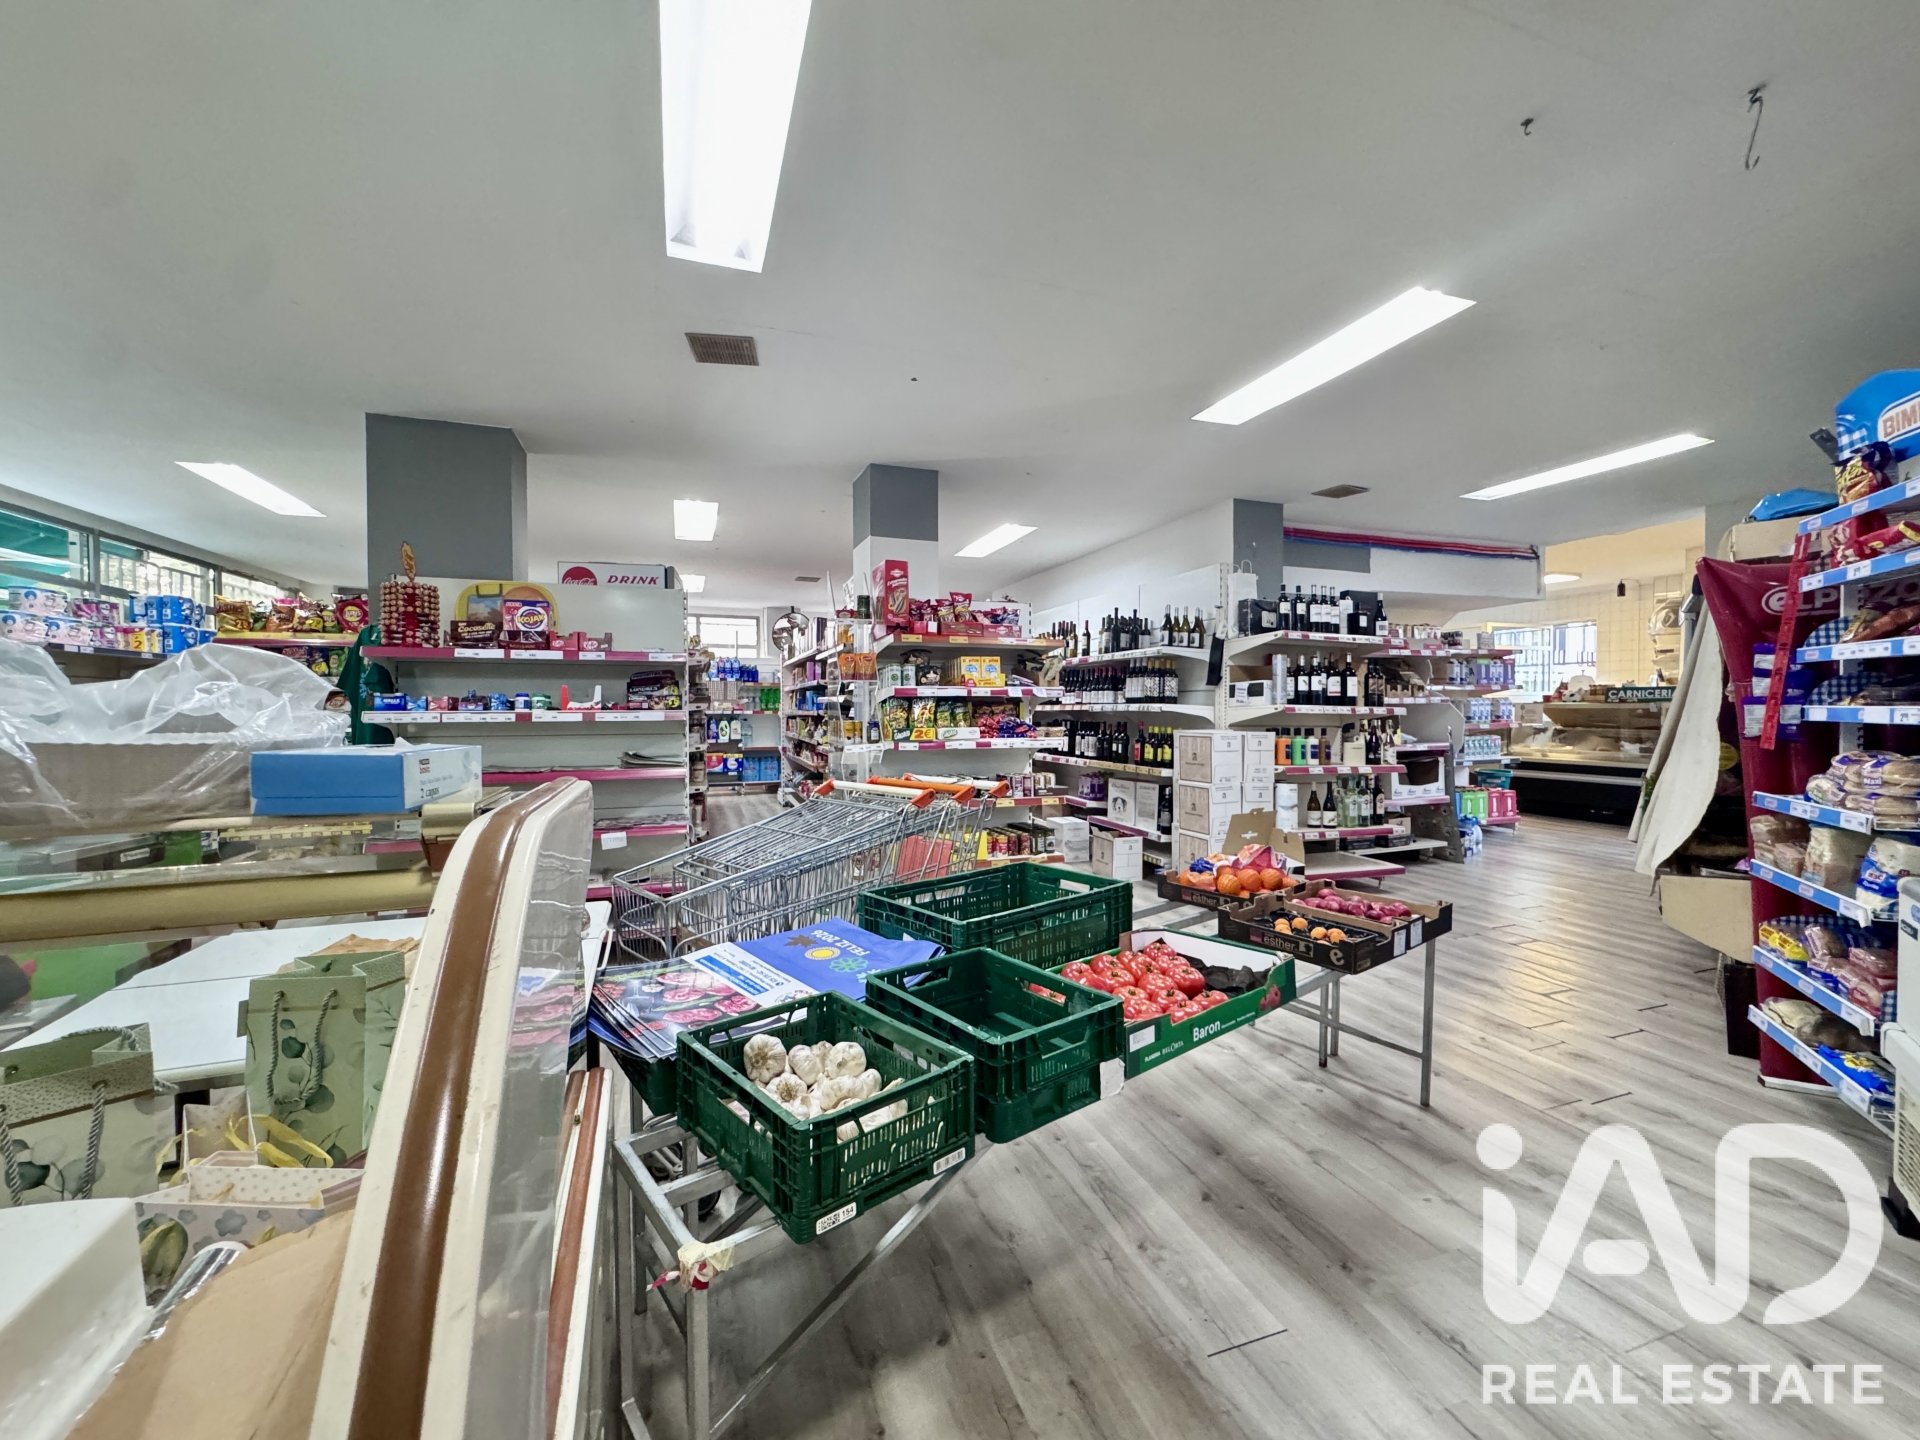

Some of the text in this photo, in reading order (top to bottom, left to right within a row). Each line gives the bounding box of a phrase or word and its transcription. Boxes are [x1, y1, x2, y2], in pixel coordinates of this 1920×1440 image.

[606, 575, 660, 585] DRINK
[517, 614, 545, 625] KOJAK
[836, 939, 871, 956] FELIZ
[1263, 935, 1296, 951] esther
[1329, 949, 1345, 966] e
[1193, 1021, 1220, 1042] Baron
[842, 1206, 854, 1217] 154
